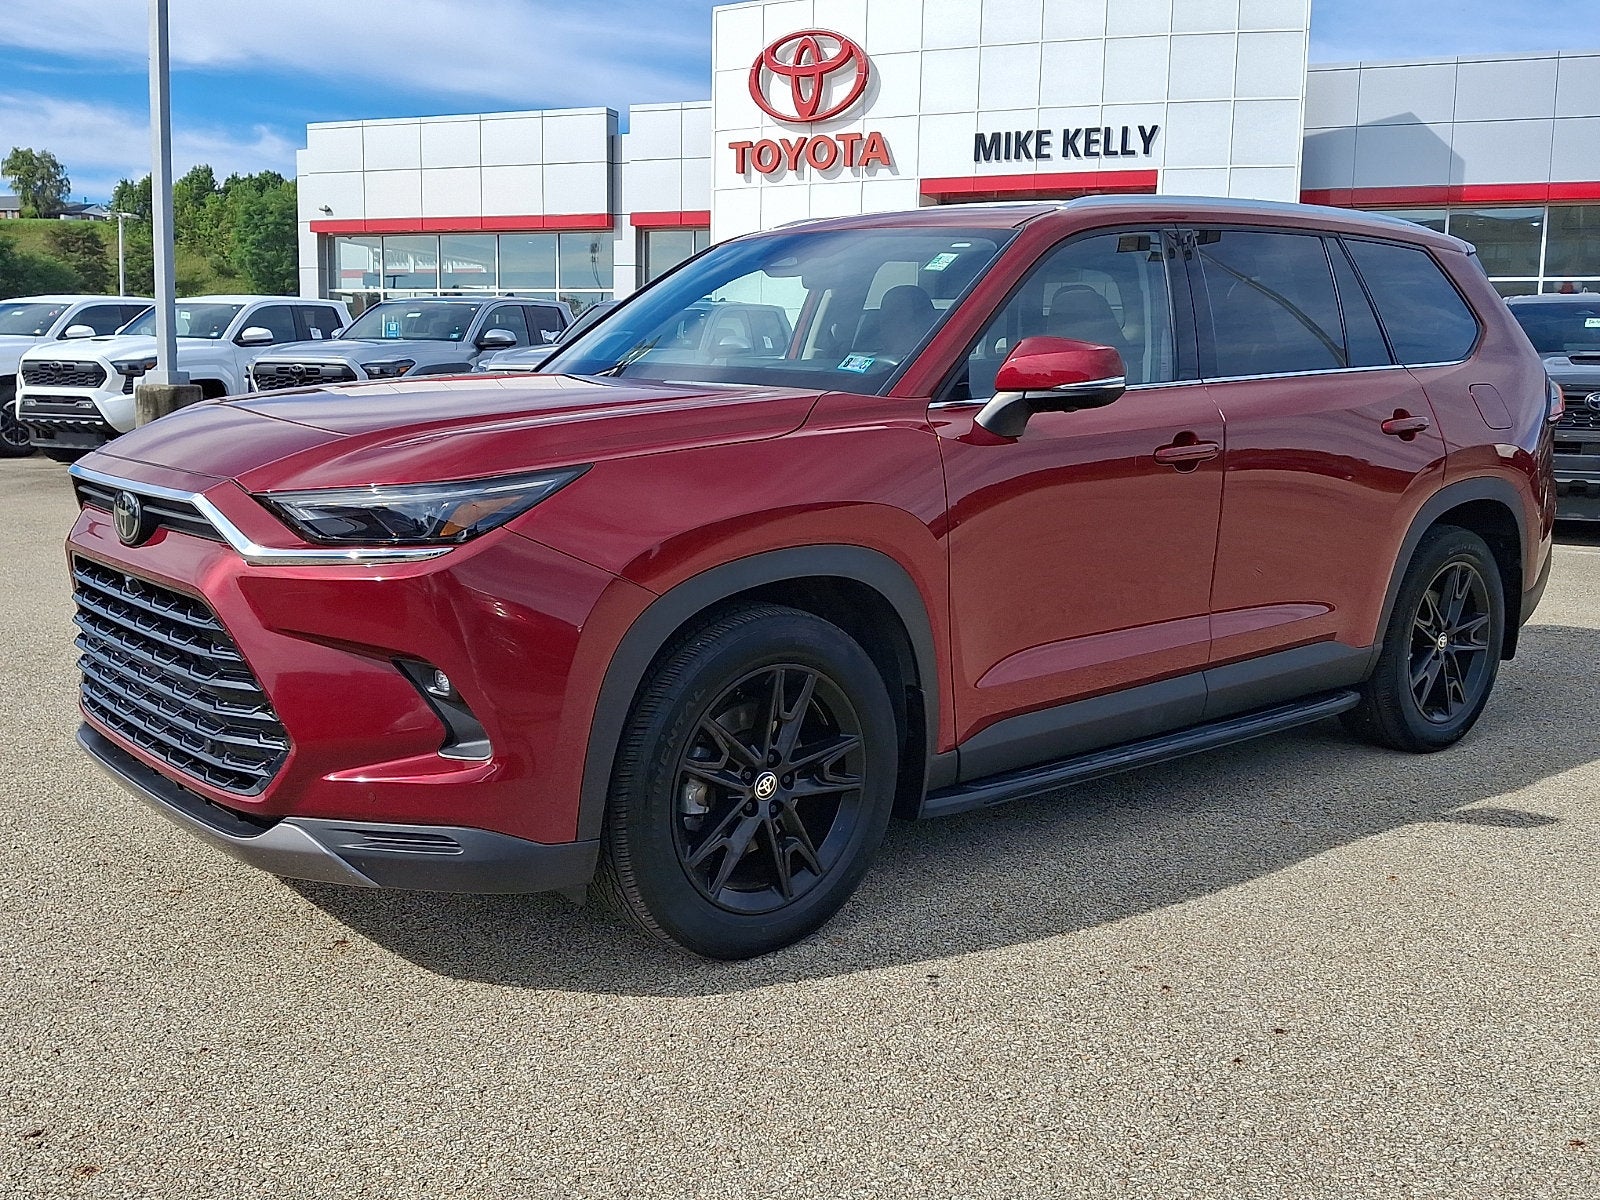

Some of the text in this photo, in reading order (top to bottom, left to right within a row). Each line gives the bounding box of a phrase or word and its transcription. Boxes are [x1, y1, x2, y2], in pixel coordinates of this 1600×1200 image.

[728, 131, 891, 174] TOYOTA
[973, 124, 1160, 162] MIKE KELLY
